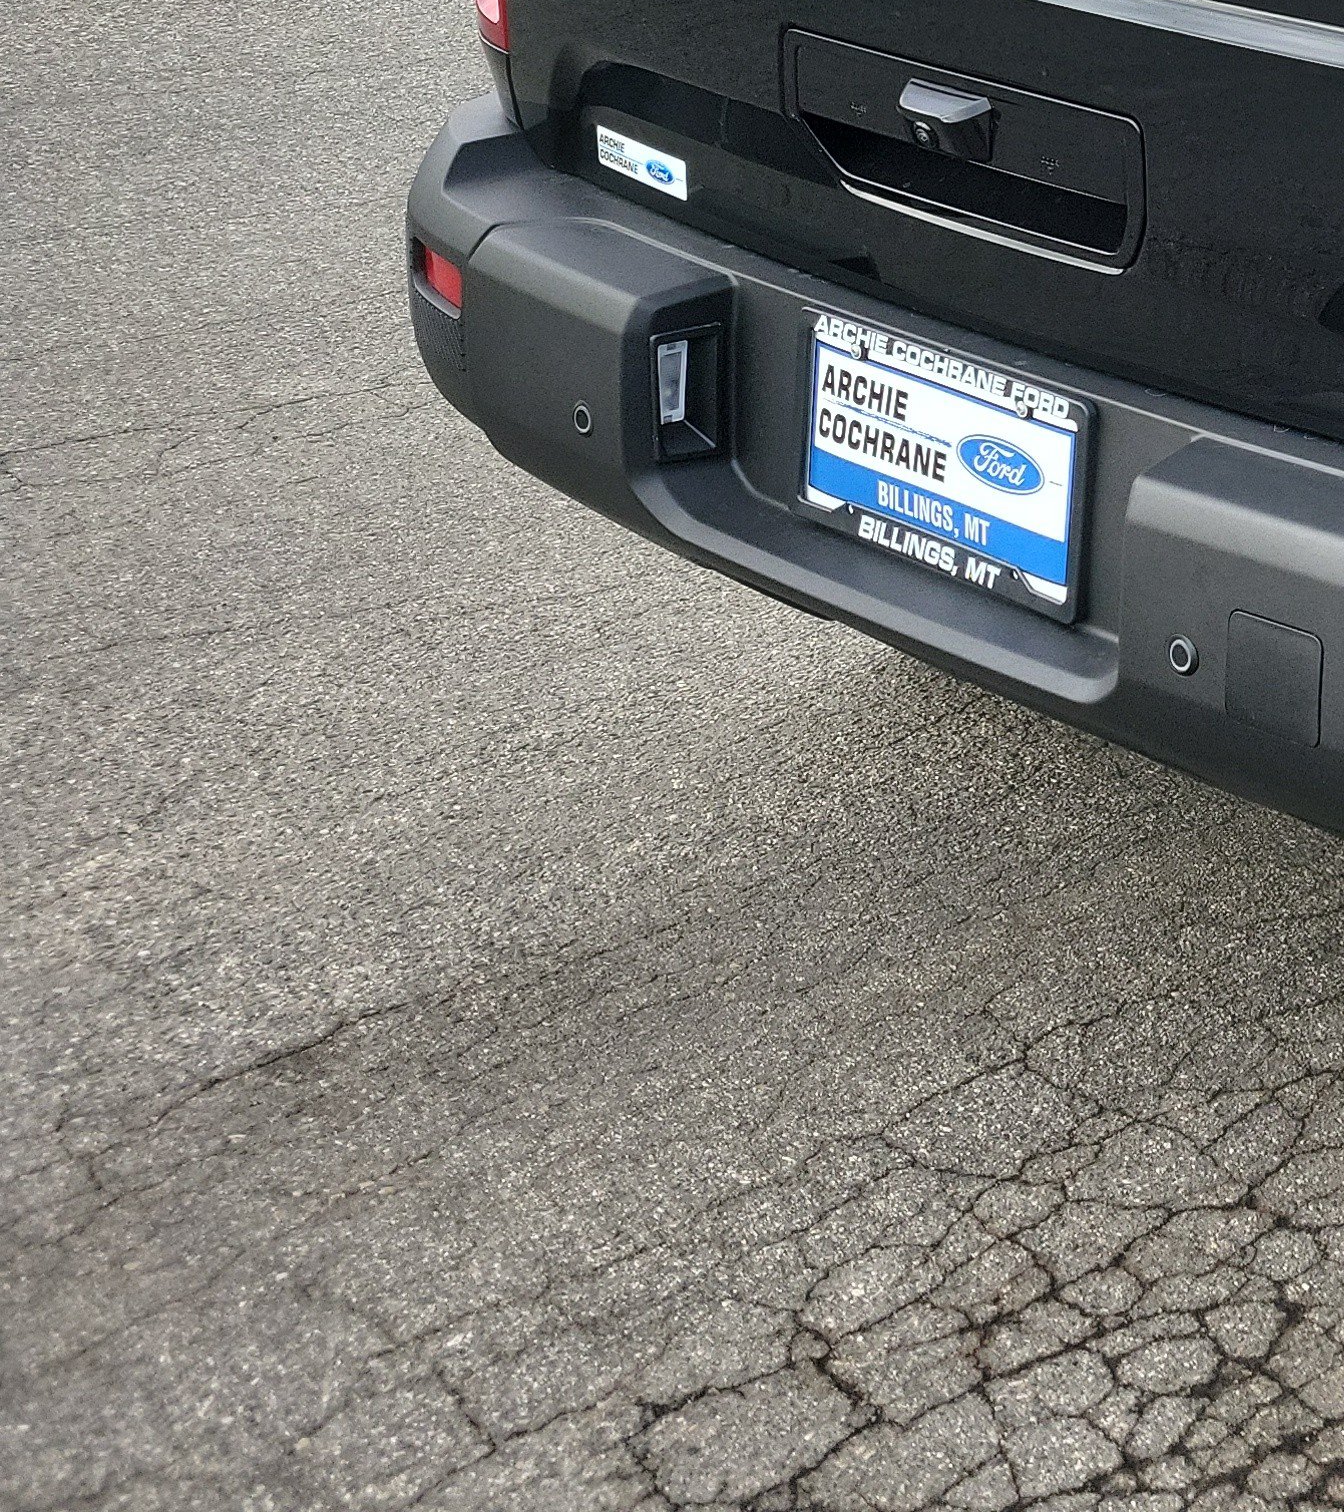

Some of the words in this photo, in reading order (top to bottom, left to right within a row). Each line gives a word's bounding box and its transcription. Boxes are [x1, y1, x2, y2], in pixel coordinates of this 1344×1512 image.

[599, 133, 625, 153] ARCHIE
[600, 149, 639, 175] COCHRANE
[648, 162, 671, 183] Ford
[814, 314, 889, 355] ARCHIE
[892, 337, 1007, 396] COCHRANE
[1008, 381, 1070, 419] FORD
[821, 364, 909, 422] ARCHIE
[818, 408, 948, 484] COCHRANE
[971, 440, 1030, 489] Ford
[877, 480, 960, 539] BILLINGS,
[964, 513, 991, 546] MT
[857, 514, 958, 577] BILLINGS,
[964, 557, 1001, 590] MT
